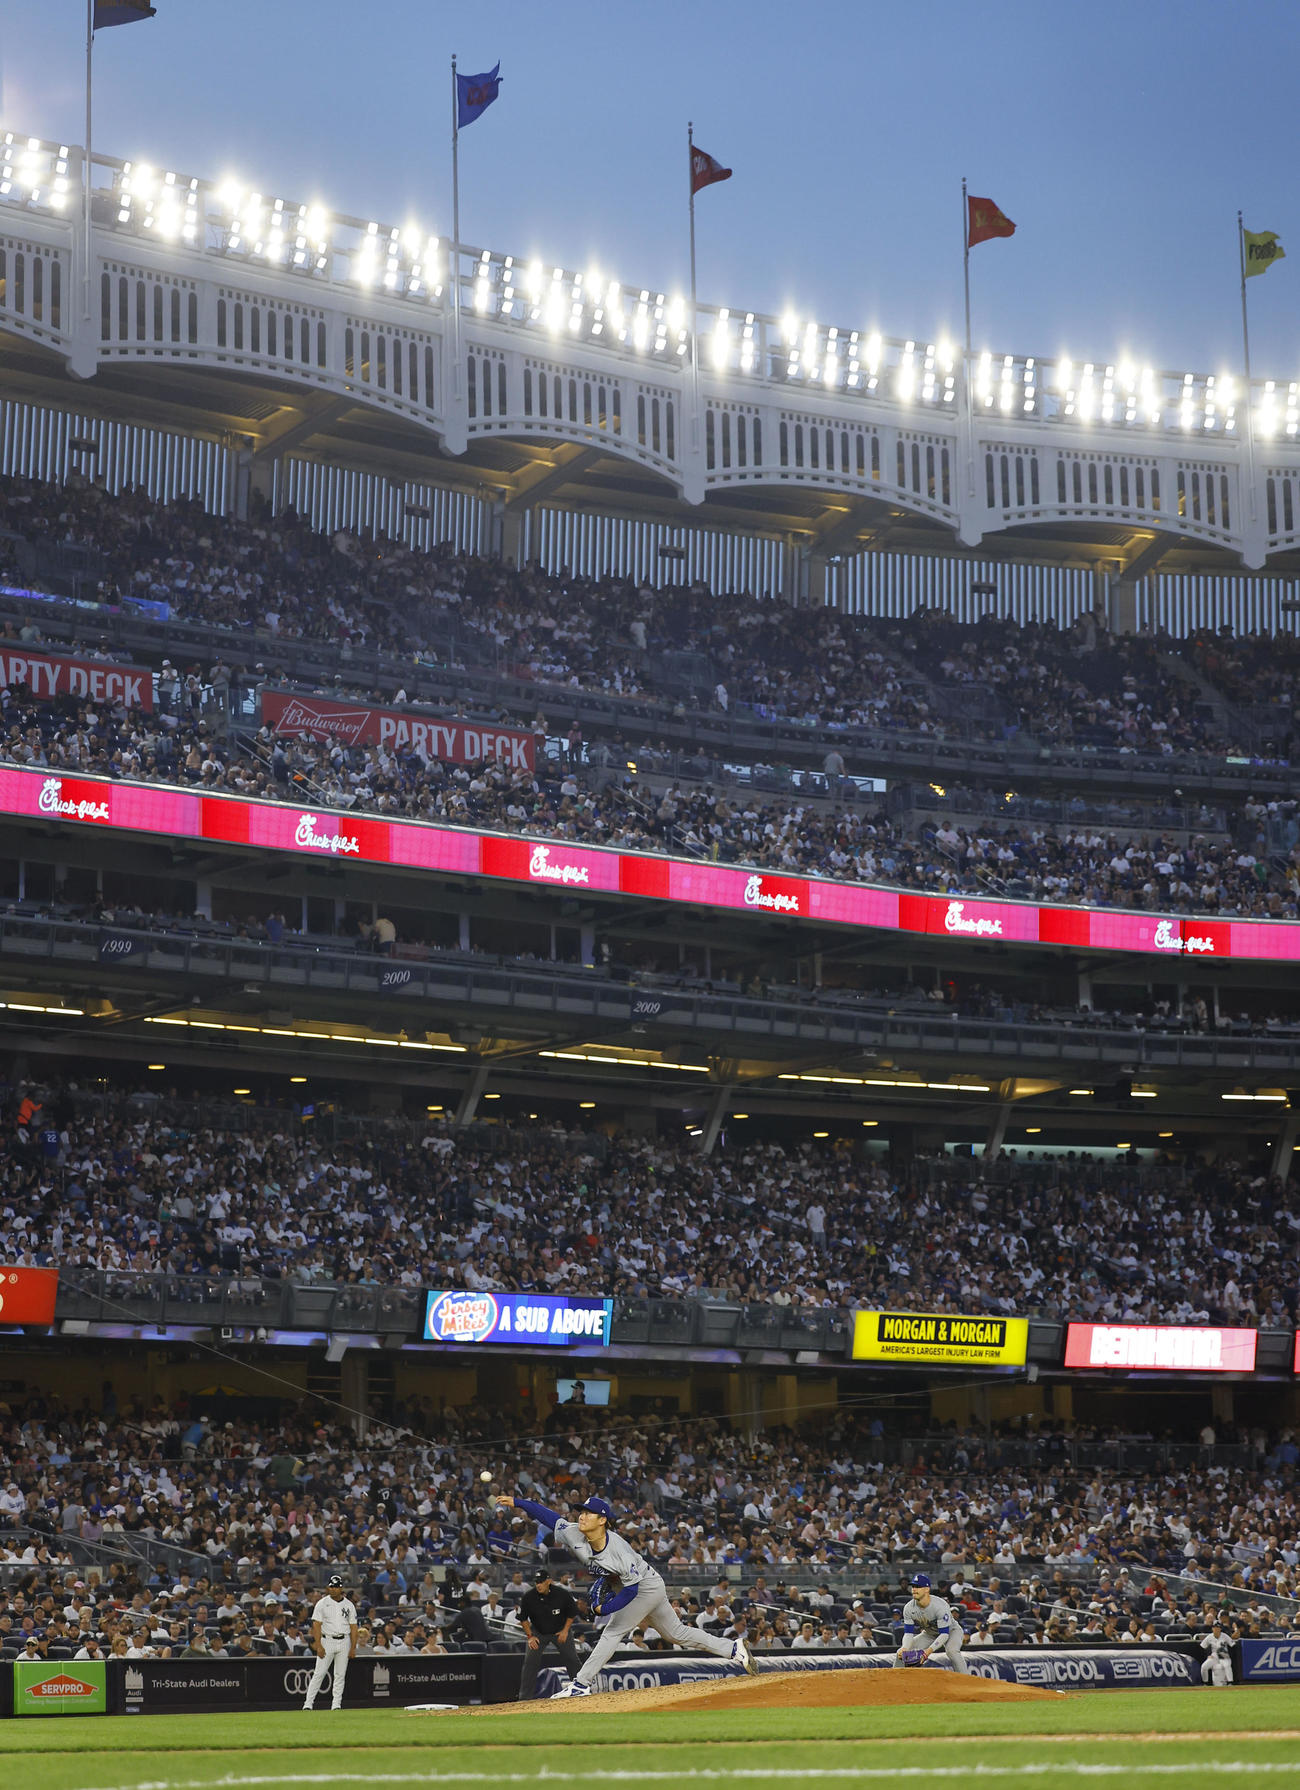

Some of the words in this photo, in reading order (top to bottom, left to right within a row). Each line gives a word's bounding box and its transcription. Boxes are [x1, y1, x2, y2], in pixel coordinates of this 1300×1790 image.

[70, 667, 142, 708] DECK
[283, 706, 360, 734] Budweiser
[380, 717, 456, 757] PARTY
[464, 730, 528, 769] DECK
[102, 940, 132, 953] 1999
[382, 970, 411, 985] 2000
[633, 1000, 661, 1014] 2009
[438, 1298, 489, 1318] Jersey
[498, 1305, 511, 1331] A
[515, 1305, 549, 1333] SUB
[550, 1308, 605, 1335] ABOVE
[884, 1318, 936, 1340] MORGAN
[938, 1321, 947, 1341] &
[950, 1322, 1000, 1343] MORGAN
[881, 1345, 915, 1354] AMERICA'S
[917, 1347, 944, 1355] LARGEST
[946, 1348, 968, 1357] INJURY
[967, 1664, 1007, 1681] OOL
[1054, 1660, 1104, 1681] COOL
[1151, 1657, 1188, 1677] COO
[152, 1679, 187, 1688] Tri-State
[189, 1679, 208, 1688] Audi
[210, 1679, 240, 1688] Dealers
[397, 1674, 428, 1682] Tri-State
[431, 1673, 448, 1681] Audi
[449, 1673, 476, 1681] Dealers
[41, 1684, 84, 1694] SERVPRO
